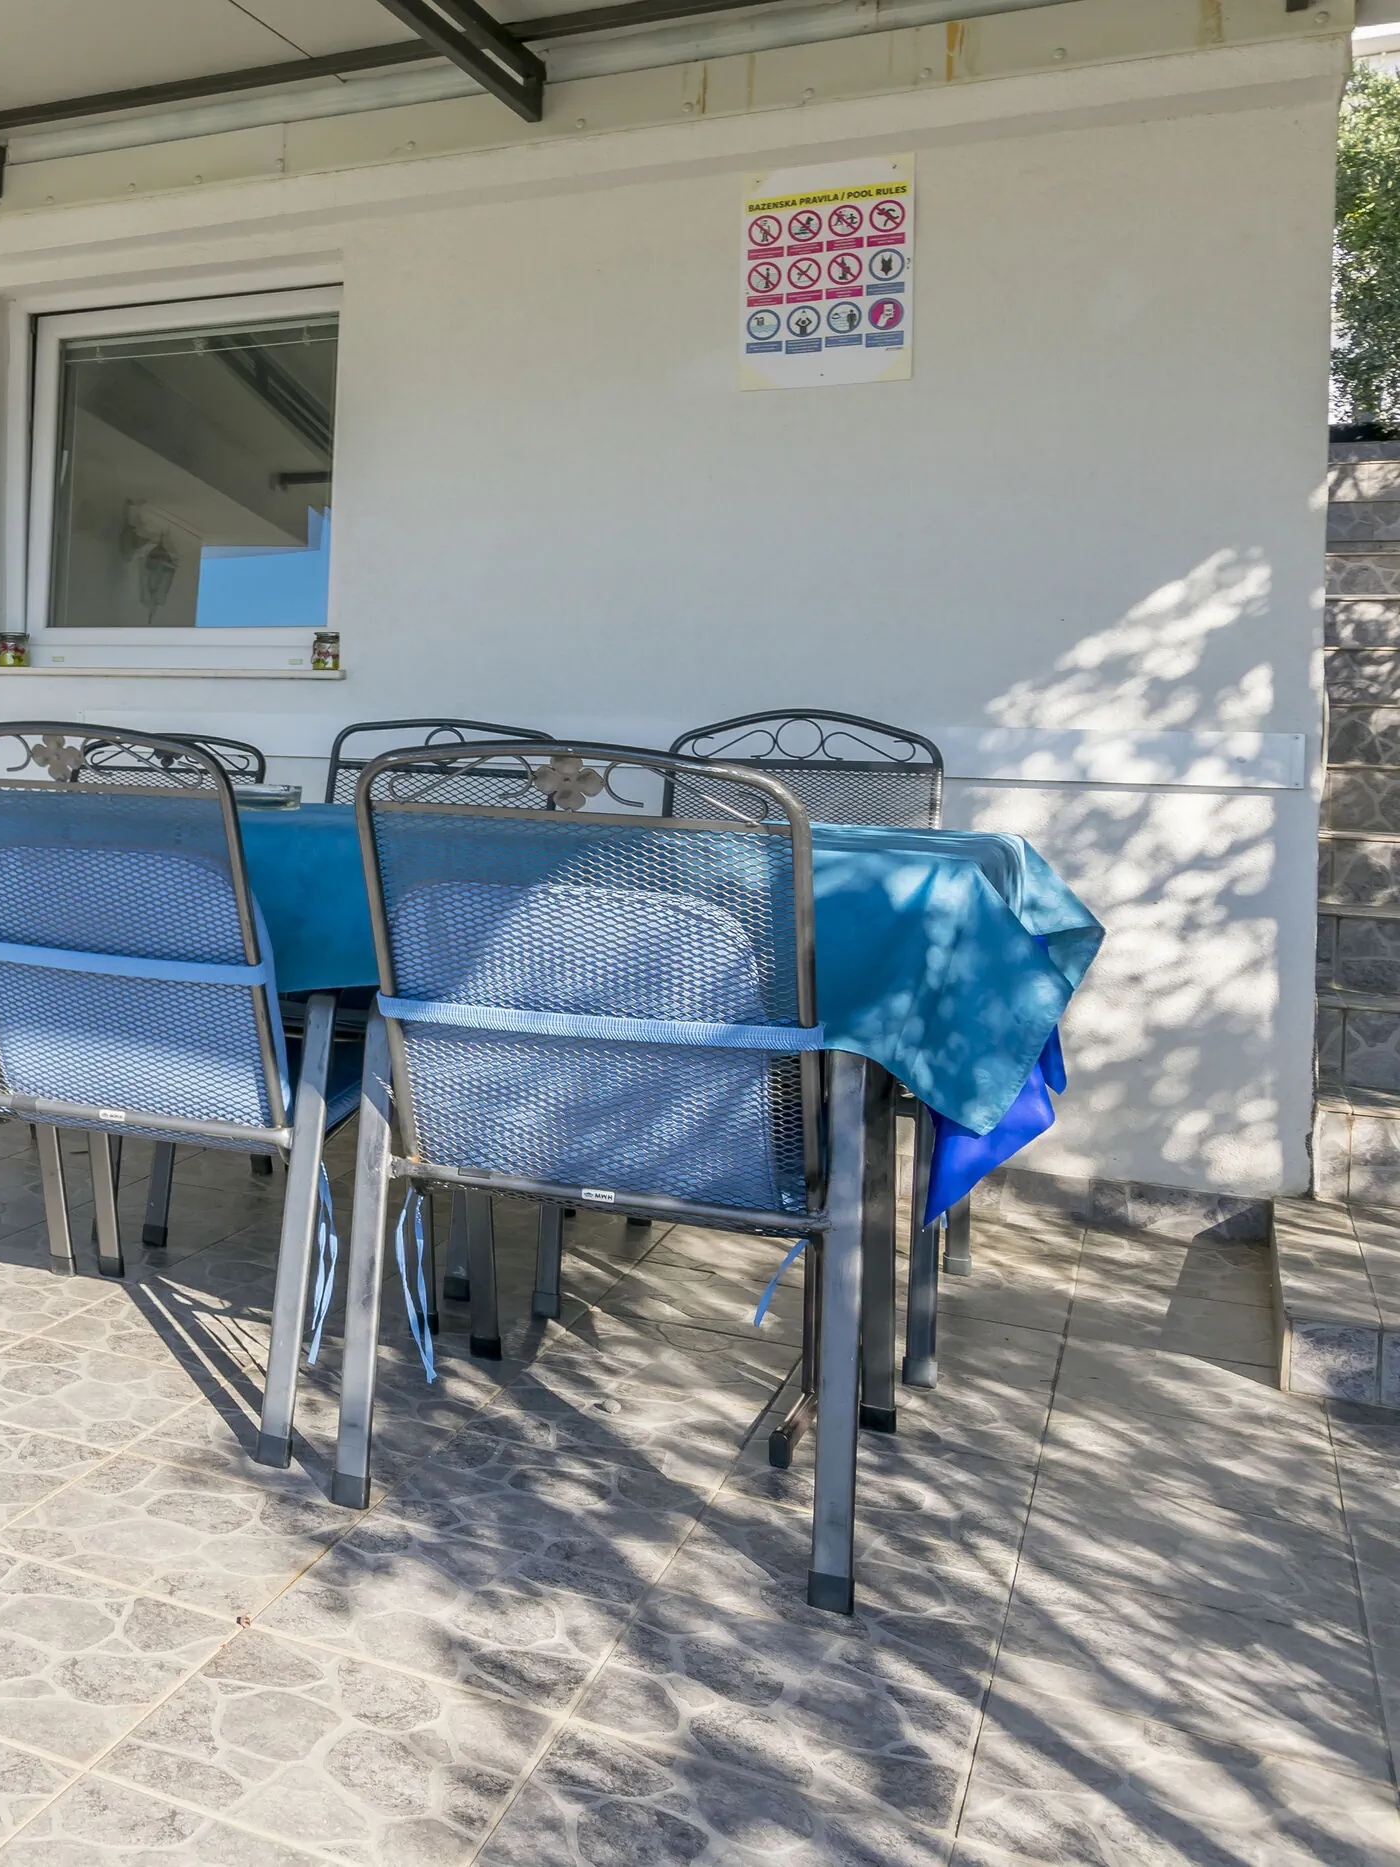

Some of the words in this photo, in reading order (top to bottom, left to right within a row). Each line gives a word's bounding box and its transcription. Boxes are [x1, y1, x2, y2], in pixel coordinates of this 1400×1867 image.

[748, 200, 797, 213] BAZENSKA
[800, 194, 839, 205] PRAVILA
[847, 190, 872, 199] POOL
[876, 185, 907, 195] RULES
